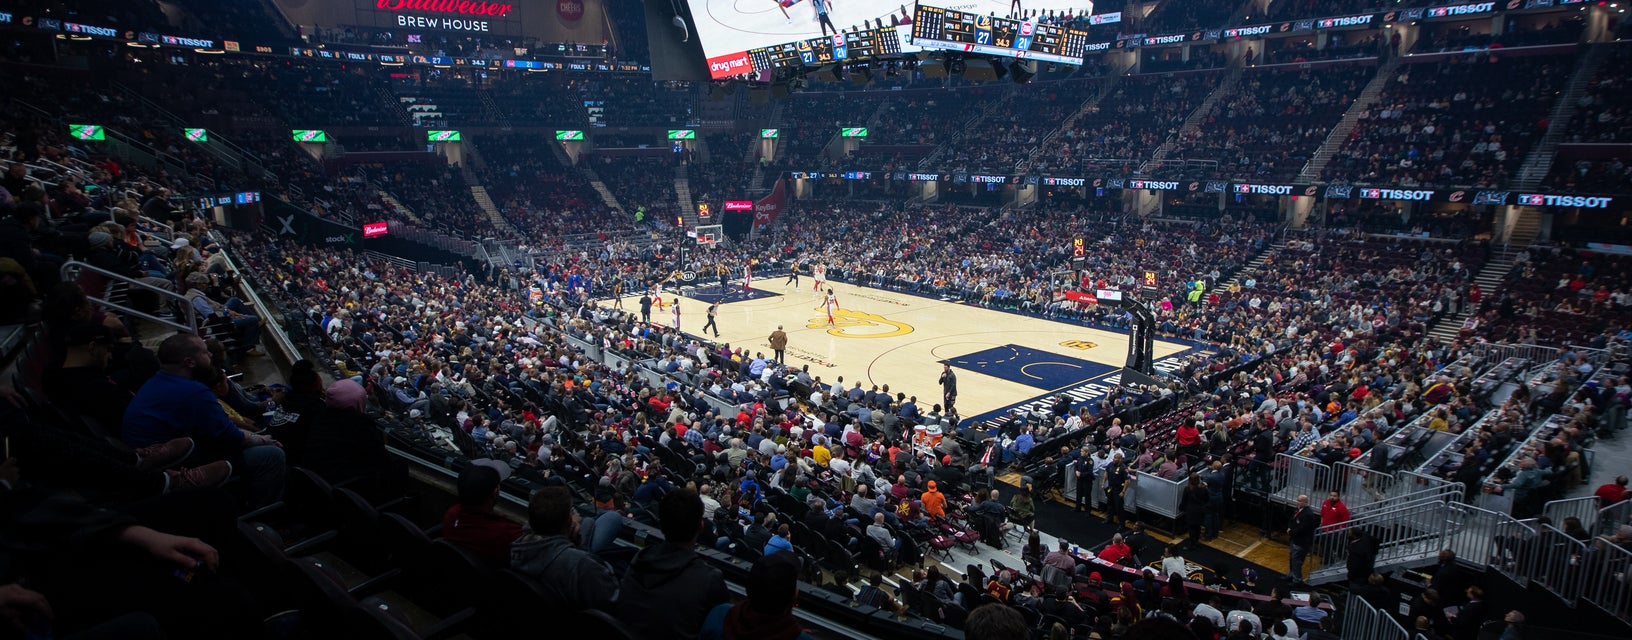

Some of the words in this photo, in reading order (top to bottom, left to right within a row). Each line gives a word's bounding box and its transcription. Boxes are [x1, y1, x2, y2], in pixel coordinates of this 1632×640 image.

[1447, 2, 1495, 15] TISSOT
[398, 15, 438, 28] BREW
[442, 18, 489, 32] HOUSE
[1333, 14, 1374, 27] TISSOT
[79, 24, 117, 37] TISSOT
[1237, 25, 1272, 36] TISSOT
[176, 37, 214, 48] TISSOT
[977, 31, 990, 45] 27
[995, 38, 1010, 48] 34.3
[1018, 37, 1028, 49] 21
[1156, 34, 1185, 44] TISSOT
[1085, 42, 1111, 51] TISSOT
[348, 52, 365, 60] FOULS
[803, 52, 813, 63] 27
[837, 47, 845, 58] 21
[711, 60, 730, 72] drug
[729, 55, 749, 68] mart
[1054, 178, 1085, 186] TISSOT
[1144, 181, 1179, 190] TISSOT
[1250, 184, 1293, 195] TISSOT
[1380, 189, 1435, 201] TISSOT
[1543, 195, 1612, 209] TISSOT
[1074, 245, 1084, 256] 24
[1146, 278, 1156, 286] 24
